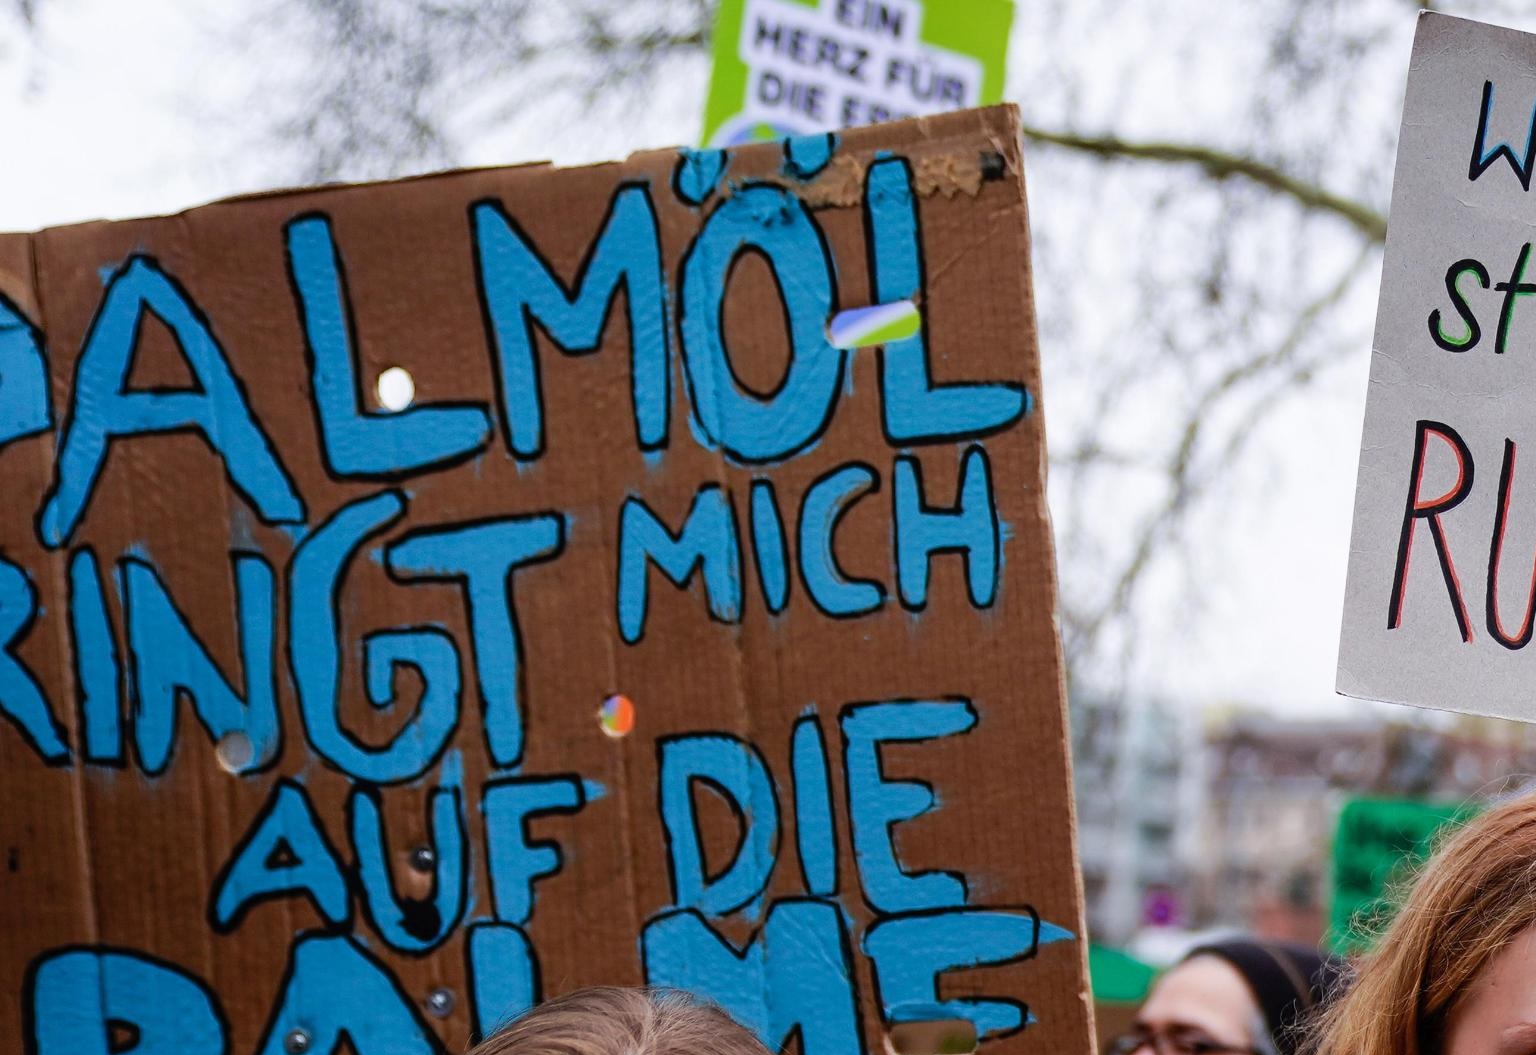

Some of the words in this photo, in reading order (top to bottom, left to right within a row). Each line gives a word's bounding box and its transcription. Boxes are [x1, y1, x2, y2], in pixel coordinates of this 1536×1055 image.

[754, 15, 868, 82] HERZ
[886, 51, 965, 106] FÜR
[835, 0, 904, 39] EIN
[757, 71, 827, 123] DIE
[616, 444, 1002, 645] MICH
[207, 772, 590, 957] AUF
[656, 694, 978, 918] DIE
